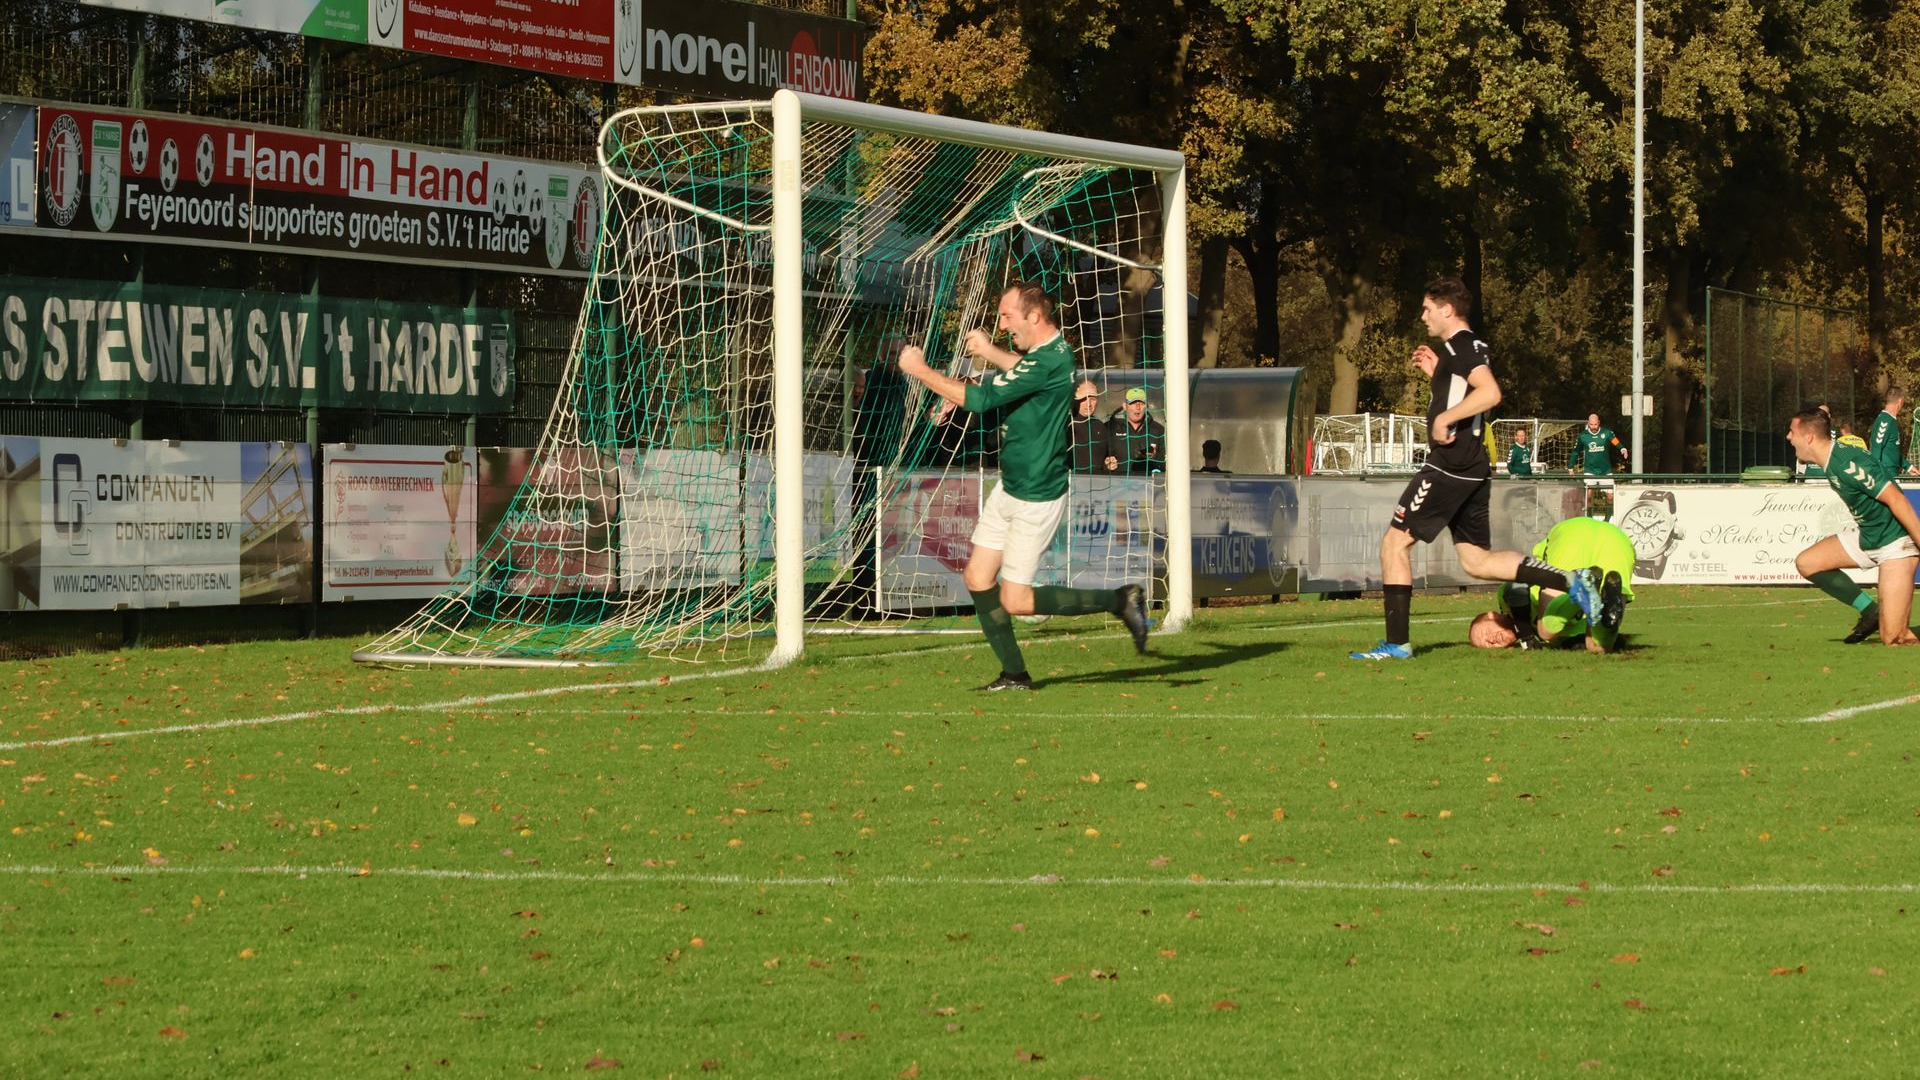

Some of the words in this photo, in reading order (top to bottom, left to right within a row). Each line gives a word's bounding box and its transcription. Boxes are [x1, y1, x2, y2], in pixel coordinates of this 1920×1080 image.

[489, 15, 505, 31] Country
[646, 21, 755, 84] norel
[759, 47, 858, 98] HALLENBOUW
[226, 133, 326, 186] Hand
[340, 144, 374, 192] in
[390, 149, 489, 206] Hand
[126, 184, 234, 230] Feyenoord
[238, 202, 344, 241] supporters
[349, 210, 421, 248] groeten
[427, 211, 461, 248] S.V.
[479, 217, 530, 254] Harde
[0, 295, 28, 381] S
[43, 297, 233, 385] STEUNEN
[246, 308, 316, 389] S.V.
[367, 317, 484, 396] HARDE
[96, 474, 215, 502] COMPANJEN
[347, 476, 369, 491] ROOS
[370, 476, 435, 492] GRAVEERTECHNIEK
[1752, 493, 1826, 516] Juwelier
[115, 522, 212, 541] CONSTRUCTIES
[216, 522, 233, 540] BV
[1700, 523, 1774, 545] Mieke's
[1778, 523, 1826, 544] Sier
[1200, 537, 1256, 575] KEUKENS
[1672, 563, 1690, 572] TW
[1692, 563, 1728, 572] STEEL
[53, 572, 232, 593] WWW.COMPANJENCONSTRUCTIES.NL
